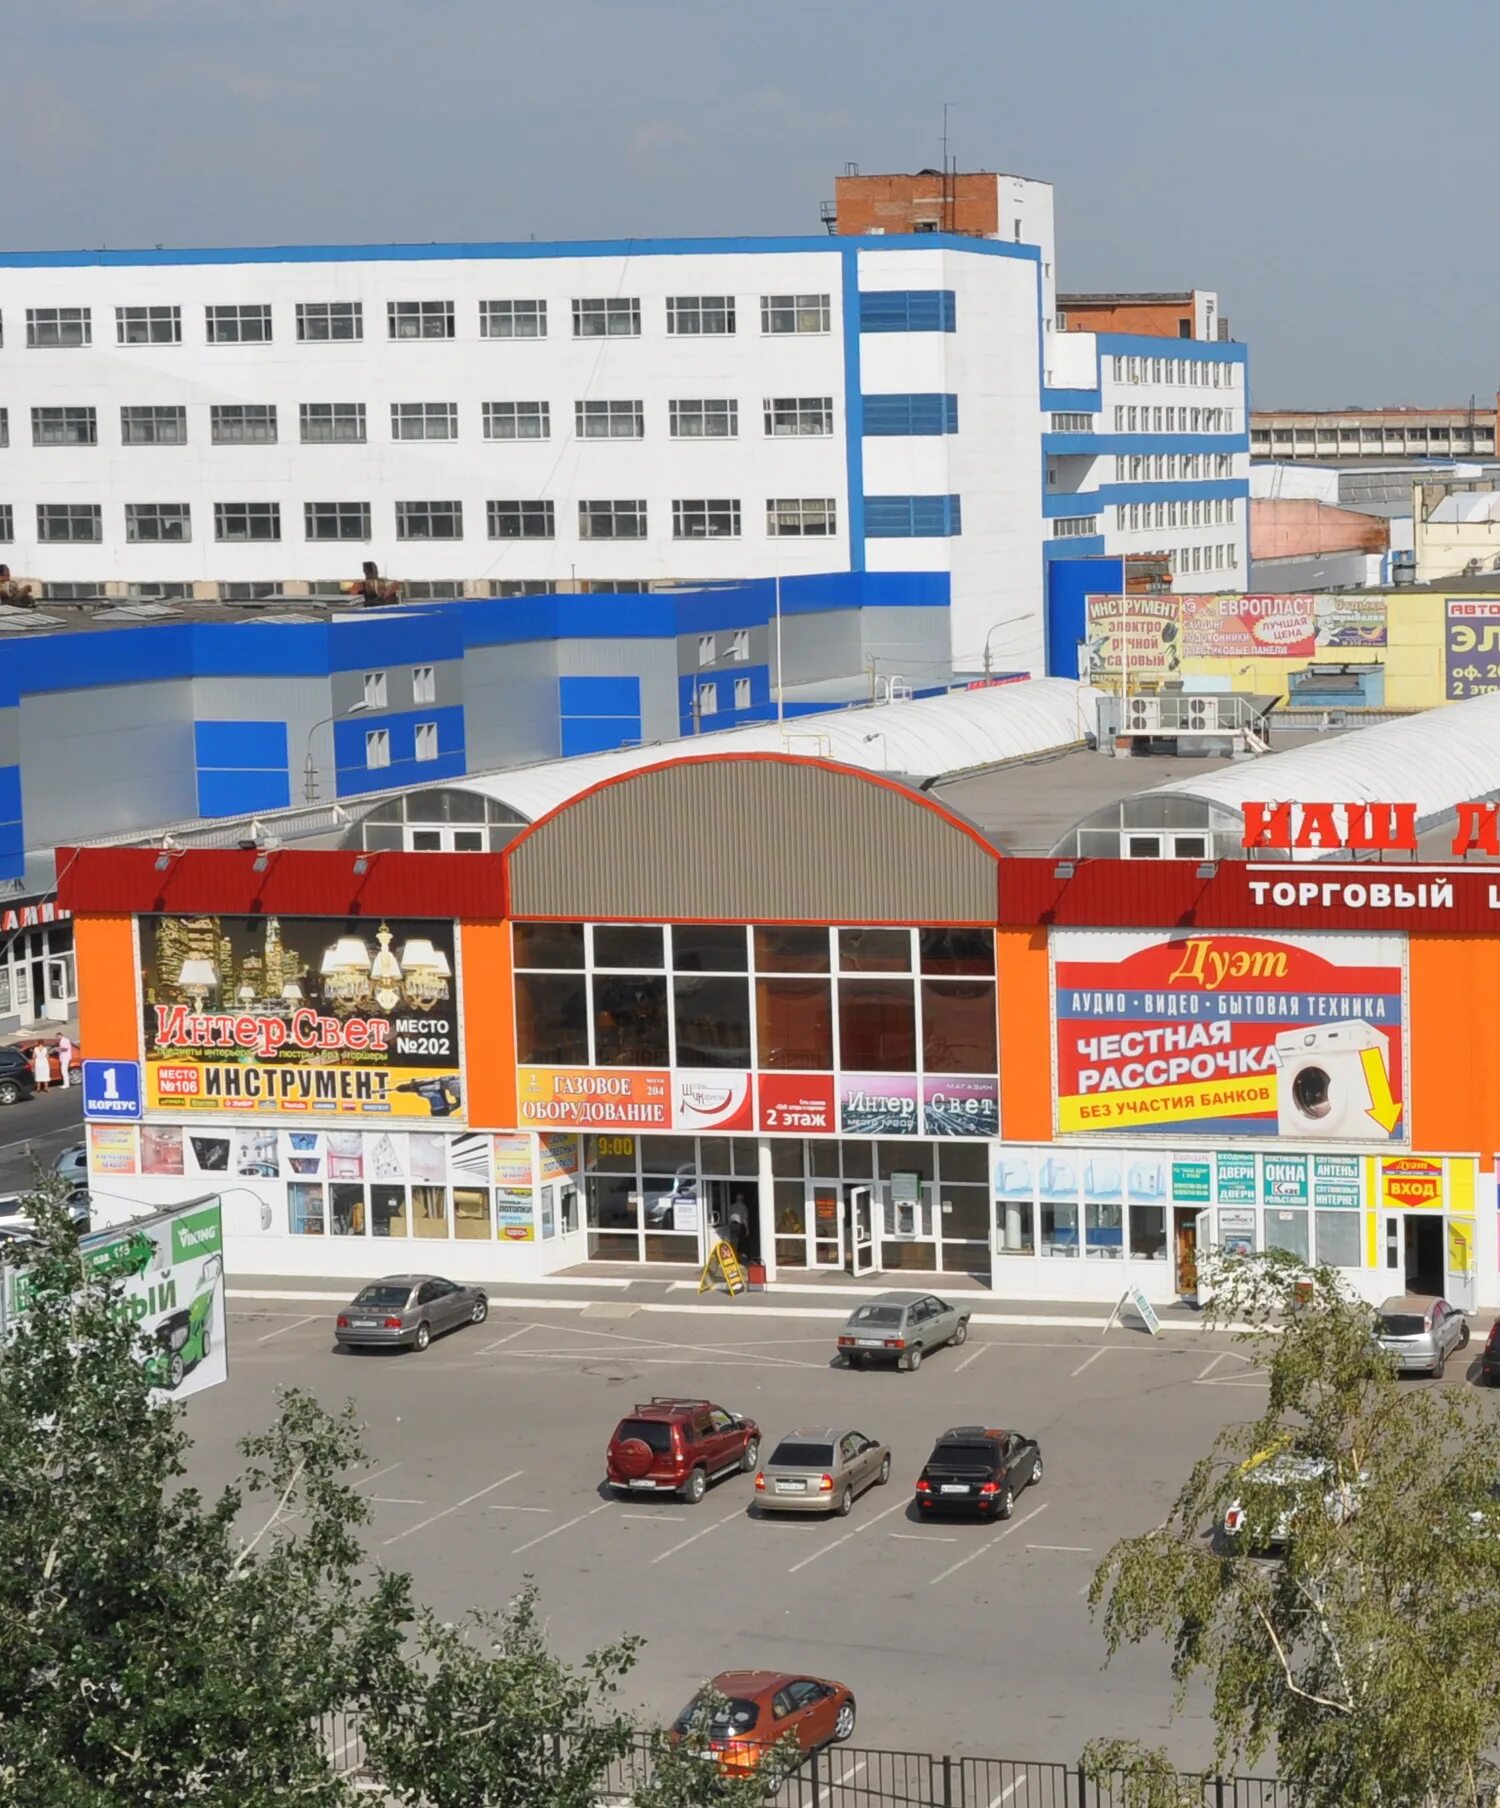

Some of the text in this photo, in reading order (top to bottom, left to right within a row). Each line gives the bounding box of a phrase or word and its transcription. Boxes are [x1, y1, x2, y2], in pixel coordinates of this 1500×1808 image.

[1090, 600, 1177, 617] ИНСТРУМЕНТ
[1219, 599, 1313, 616] ЕВРОПЛАСТ
[1108, 621, 1161, 634] электро
[1262, 617, 1308, 631] ЛУЧШАЯ
[1274, 629, 1303, 640] ЦЕНА
[1251, 646, 1288, 655] ПАНЕЛИ
[1452, 665, 1482, 680] оф.
[1453, 683, 1463, 695] 2
[1242, 802, 1417, 849] НАШ
[1249, 878, 1453, 908] ТОРГОВЫЙ
[1168, 939, 1287, 990] Дуэт
[1072, 992, 1385, 1018] АУДИО ВИДЕО БЫТОВАЯ ТЕХНИКА
[396, 1019, 449, 1034] МЕСТО
[396, 1037, 449, 1055] №202
[1076, 1020, 1231, 1062] ЧЕСТНАЯ
[159, 1069, 197, 1079] МЕСТО
[1077, 1045, 1283, 1094] РАССРОЧКА
[103, 1068, 119, 1098] 1
[160, 1081, 197, 1092] №106
[205, 1067, 389, 1099] ИНСТРУМЕНТ
[529, 1075, 536, 1085] 2
[553, 1076, 632, 1095] ГАЗОВОЕ
[647, 1086, 664, 1095] 204
[88, 1100, 136, 1110] КОРПУС
[847, 1091, 914, 1117] Интер
[932, 1093, 992, 1114] Свет
[1079, 1087, 1270, 1119] БЕЗ УЧАСТИЯ БАНКОВ
[523, 1102, 664, 1122] ОБОРУДОВАНИЕ
[766, 1110, 826, 1126] 2 этаж
[1219, 1166, 1254, 1180] ДВЕРИ
[1266, 1165, 1305, 1182] ОКНА
[1220, 1190, 1254, 1199] ДВЕРИ
[1391, 1183, 1434, 1197] ВХОД
[1316, 1195, 1357, 1205] ИНТЕРНЕТ
[179, 1226, 217, 1247] VIKING
